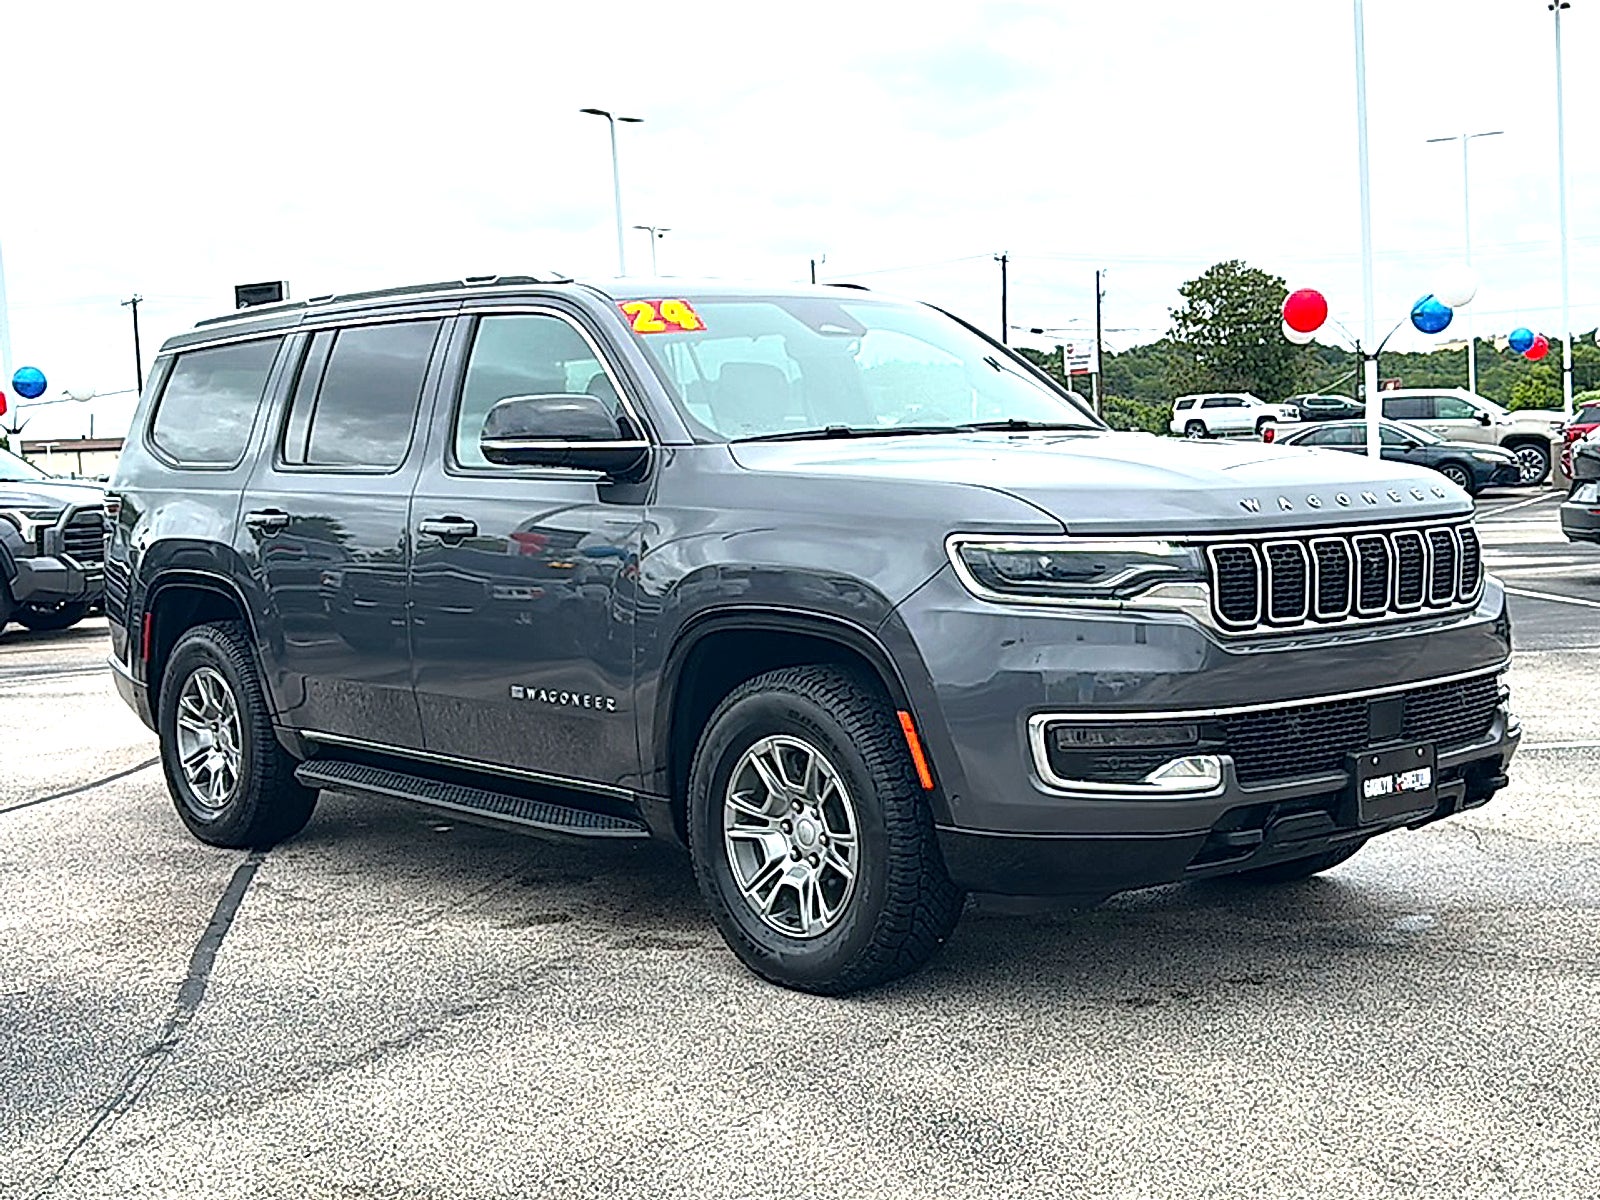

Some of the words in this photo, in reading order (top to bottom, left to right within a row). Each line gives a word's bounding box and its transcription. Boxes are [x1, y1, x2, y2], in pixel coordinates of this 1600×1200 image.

[621, 300, 699, 332] 24
[1239, 487, 1446, 513] WAGONEER
[526, 687, 616, 712] WAGONEER
